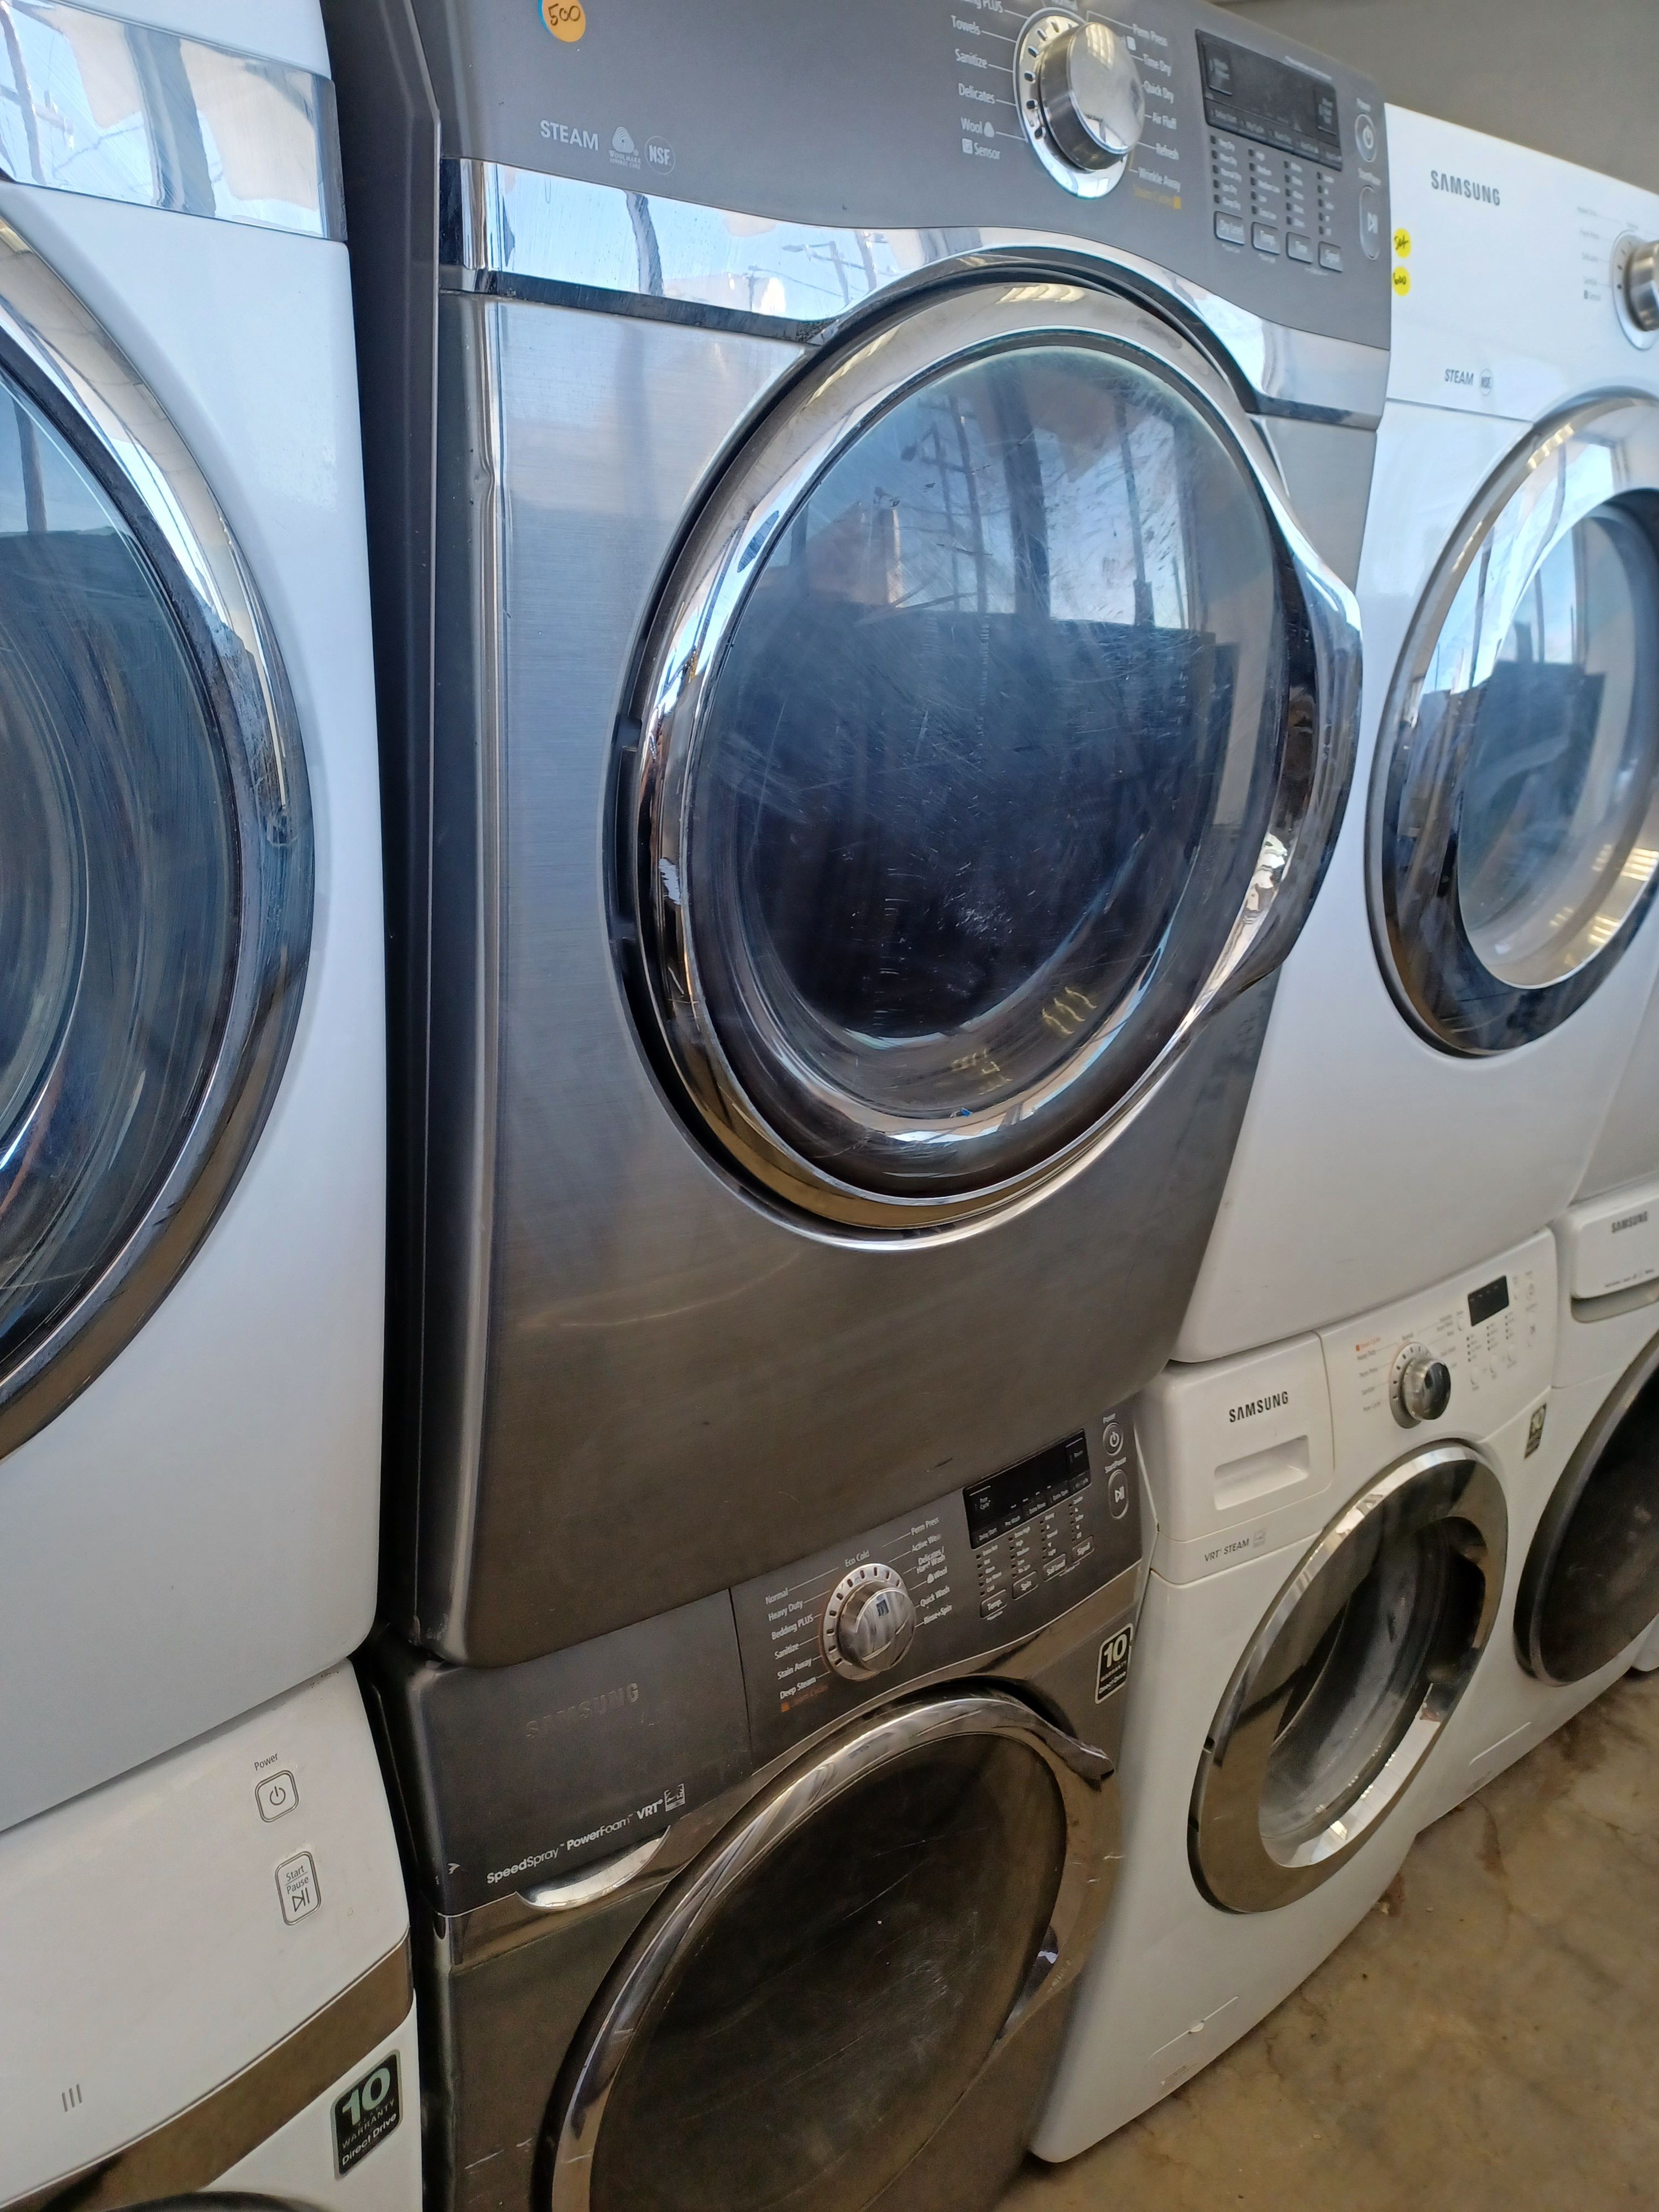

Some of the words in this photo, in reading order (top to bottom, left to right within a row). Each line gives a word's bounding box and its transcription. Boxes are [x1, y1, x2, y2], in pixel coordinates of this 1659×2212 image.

[548, 3, 581, 26] 500
[950, 15, 981, 35] Towels
[958, 82, 995, 104] Delicates
[960, 117, 983, 134] Wool
[540, 119, 599, 151] STEAM
[648, 144, 671, 166] NSF
[974, 142, 1001, 160] Sensor
[1430, 170, 1501, 206] SAMSUNG
[1444, 368, 1474, 386] STEAM
[1229, 1391, 1289, 1423] SAMSUNG
[844, 1557, 856, 1568] Eco
[856, 1550, 870, 1563] Cold
[1204, 1549, 1219, 1562] VRT
[1223, 1537, 1250, 1555] STEAM
[765, 1587, 789, 1605] Normal
[768, 1606, 789, 1622] Heavy
[787, 1600, 804, 1613] Duty
[771, 1620, 798, 1640] Bedding
[797, 1613, 814, 1627] PLUS
[774, 1642, 800, 1660] Sanitize
[1104, 1634, 1128, 1668] 10
[777, 1663, 794, 1680] Stain
[794, 1657, 813, 1671] Away
[780, 1686, 796, 1700] Deep
[796, 1676, 817, 1690] Steam
[254, 1753, 278, 1771] Power
[636, 1800, 660, 1820] VRT
[285, 1865, 305, 1881] Start
[286, 1876, 309, 1895] Pause
[342, 2067, 391, 2126] 10
[342, 2098, 395, 2149] WARRANTY
[342, 2135, 371, 2166] Direct
[372, 2112, 397, 2139] Drive
